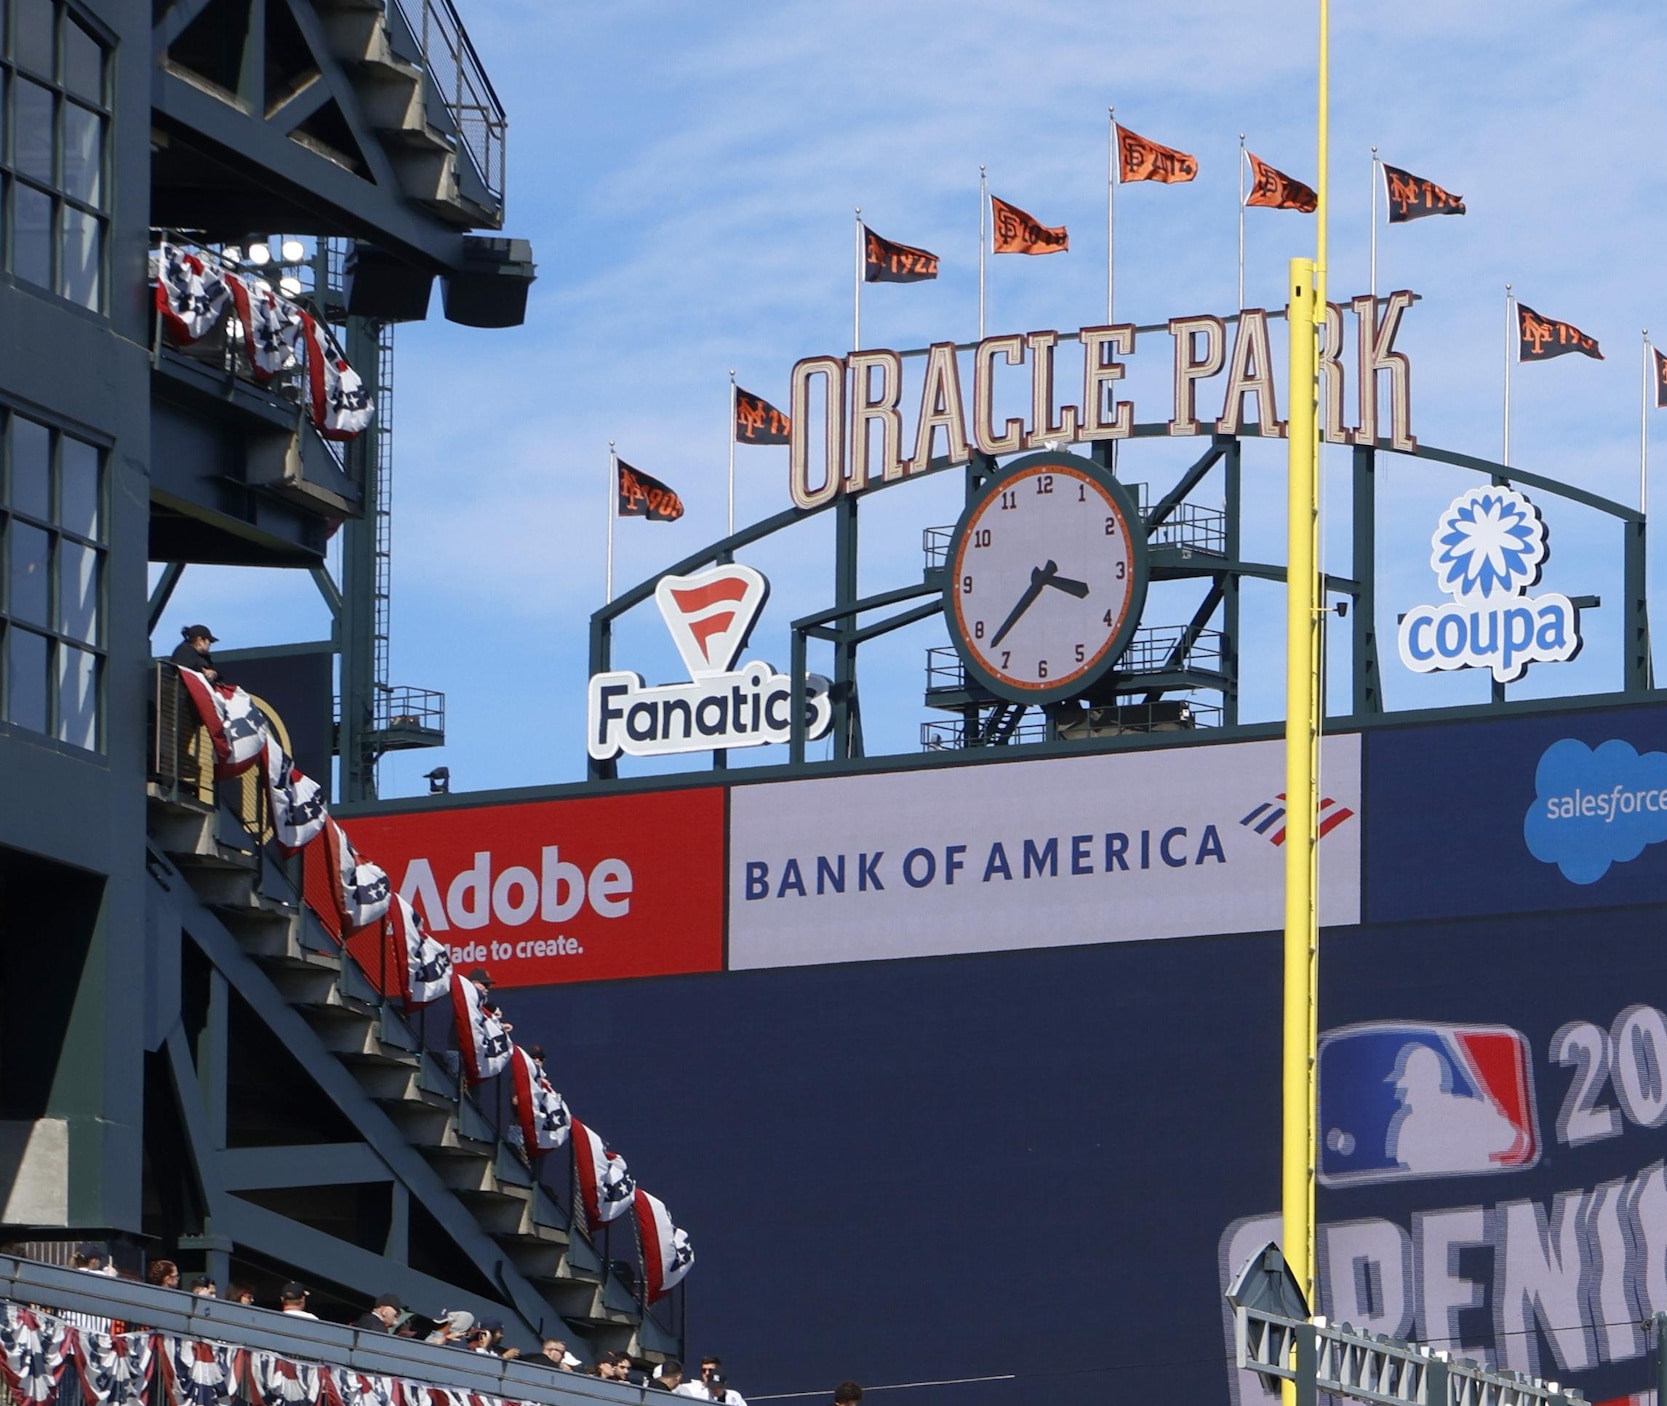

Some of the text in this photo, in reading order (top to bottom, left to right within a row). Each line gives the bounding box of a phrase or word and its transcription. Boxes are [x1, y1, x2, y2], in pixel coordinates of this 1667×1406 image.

[790, 290, 1417, 510] ORACLE PARK
[1036, 475, 1054, 494] 12
[1078, 484, 1086, 502] 1
[1001, 491, 1017, 510] 11
[1105, 517, 1115, 535] 2
[974, 529, 991, 548] 10
[1116, 561, 1125, 579] 3
[963, 576, 973, 593] 9
[1103, 609, 1113, 627] 4
[975, 621, 984, 639] 8
[1409, 604, 1566, 669] coupa
[1002, 651, 1012, 669] 7
[1075, 644, 1085, 662] 5
[1038, 660, 1048, 678] 6
[599, 677, 820, 742] Fanatics
[745, 821, 1227, 901] BANK OF AMERICA
[399, 845, 633, 931] Adobe
[490, 940, 512, 961] to
[516, 935, 584, 960] create.
